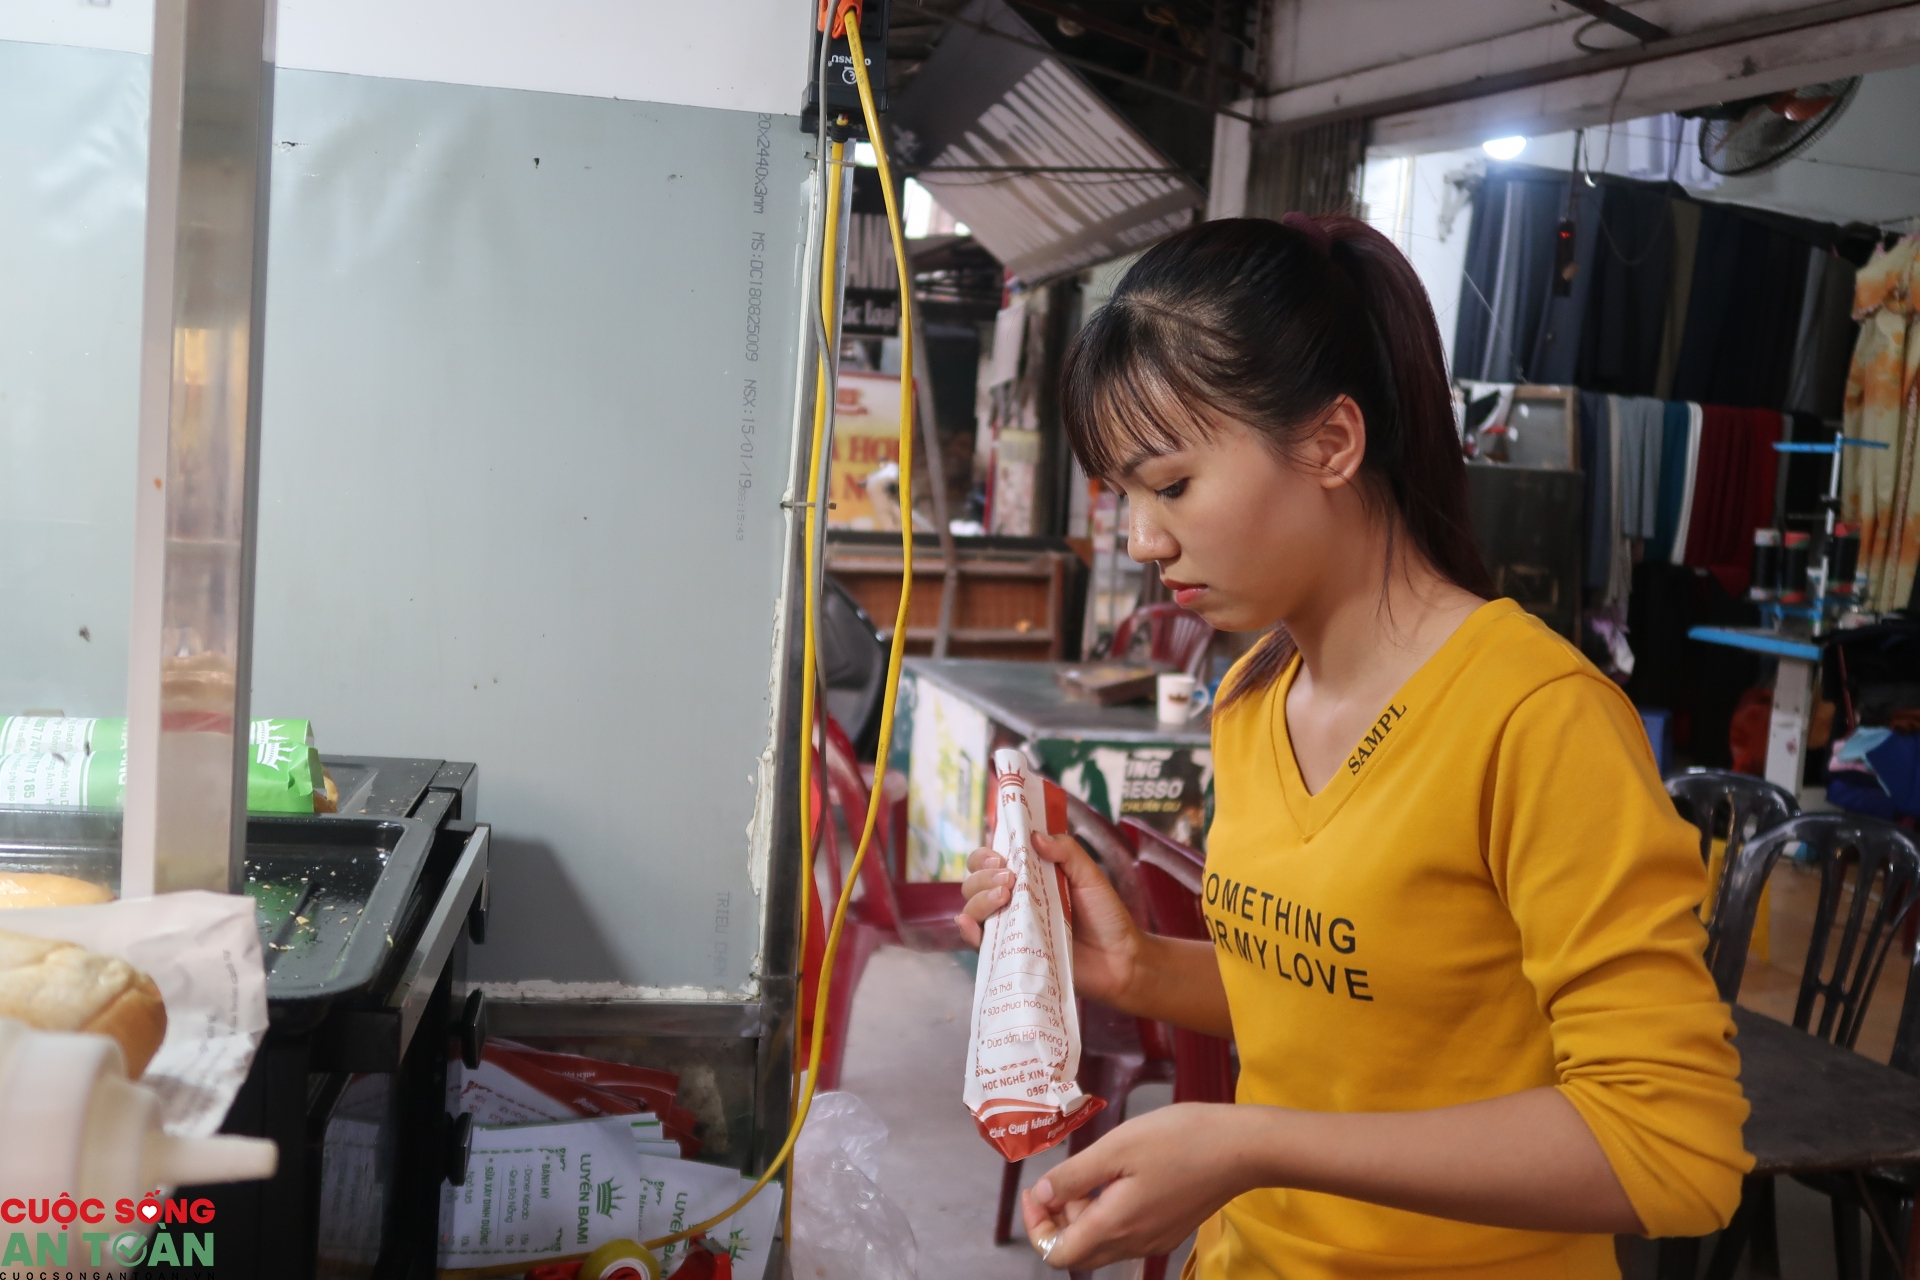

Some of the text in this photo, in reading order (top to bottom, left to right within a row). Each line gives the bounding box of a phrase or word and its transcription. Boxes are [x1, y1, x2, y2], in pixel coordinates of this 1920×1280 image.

[23, 778, 35, 798] 185
[1203, 872, 1356, 954] OMETHING
[1234, 926, 1268, 970] MY
[1276, 944, 1374, 1002] LOVE
[1024, 999, 1042, 1009] hoa
[1028, 1070, 1044, 1081] XIN
[1027, 1084, 1049, 1098] 0967
[577, 1206, 589, 1244] BAMI
